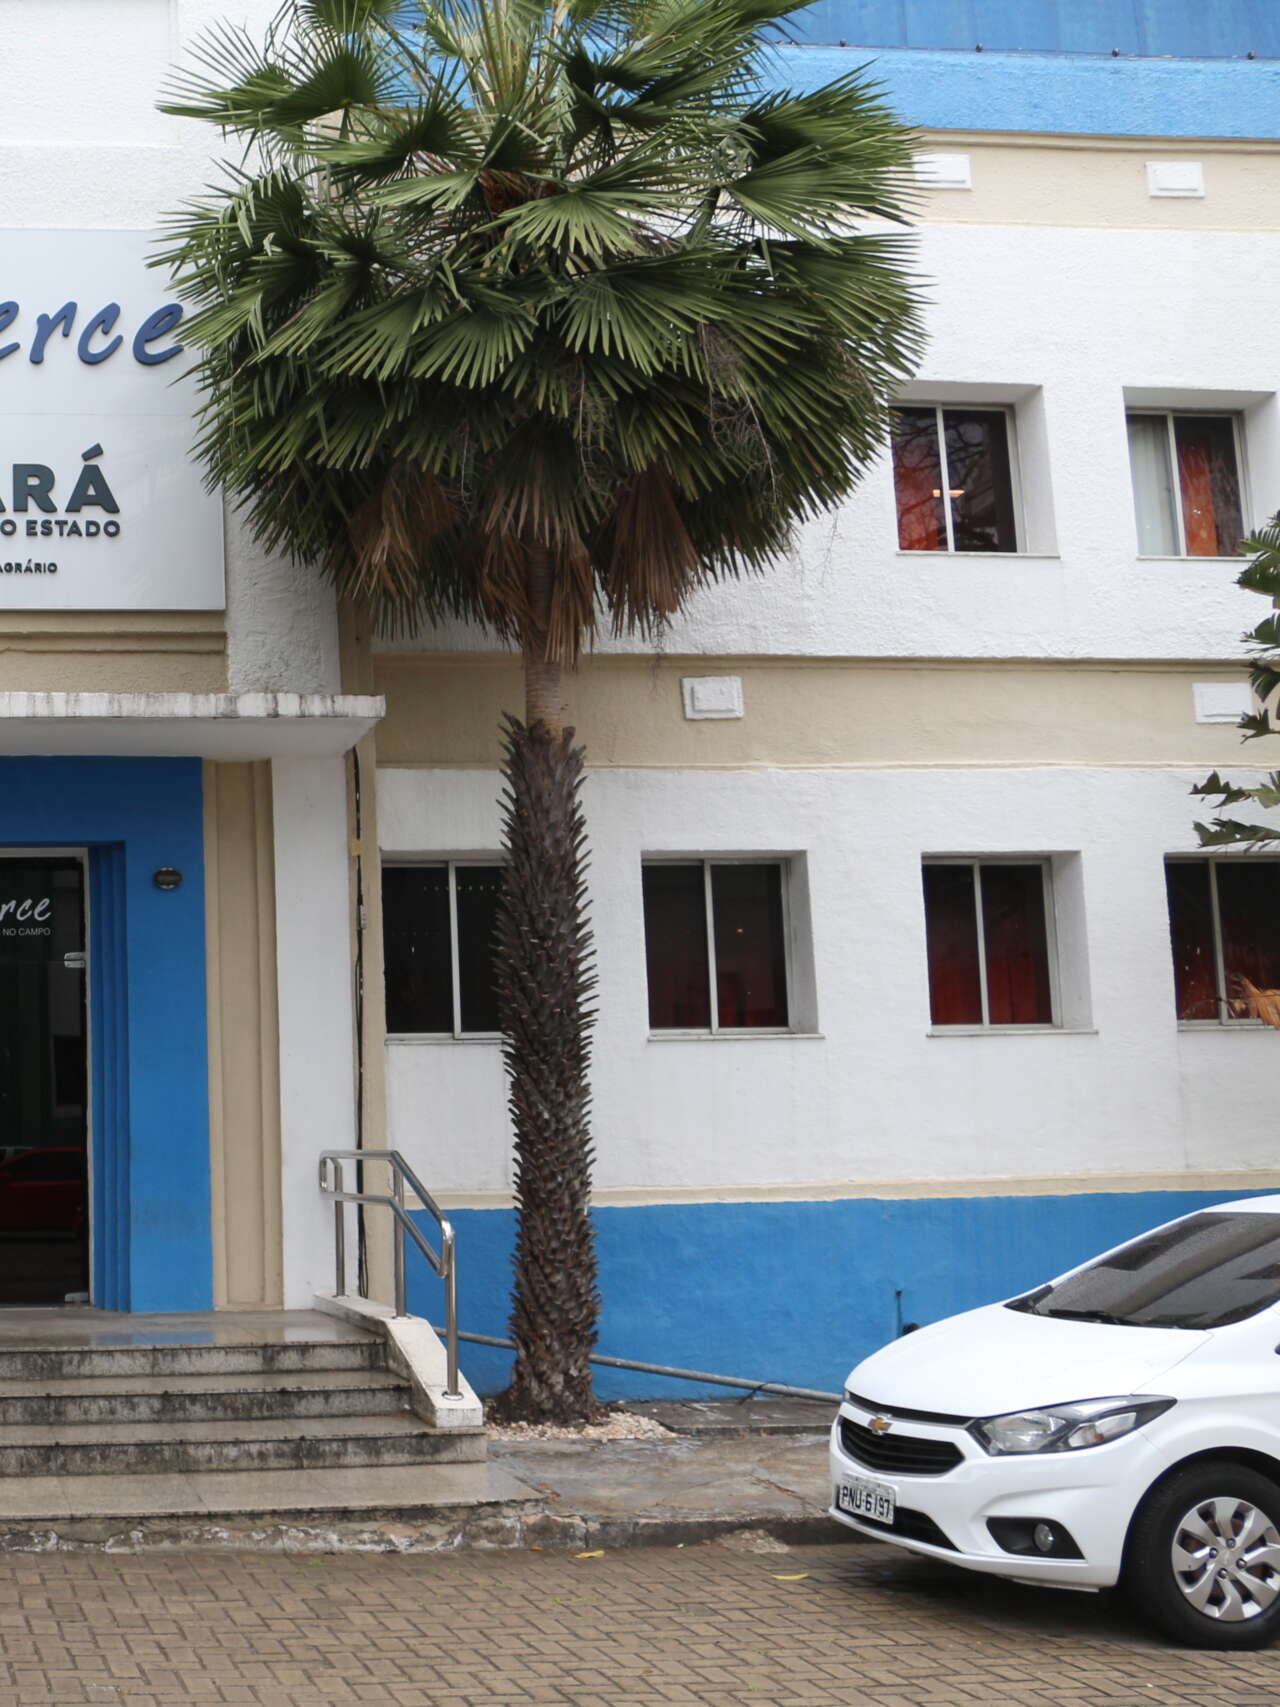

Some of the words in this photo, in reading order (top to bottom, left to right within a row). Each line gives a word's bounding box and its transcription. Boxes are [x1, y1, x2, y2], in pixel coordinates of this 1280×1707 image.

[25, 519, 121, 538] ESTADO
[2, 927, 16, 936] NO
[18, 927, 51, 936] CAMPO
